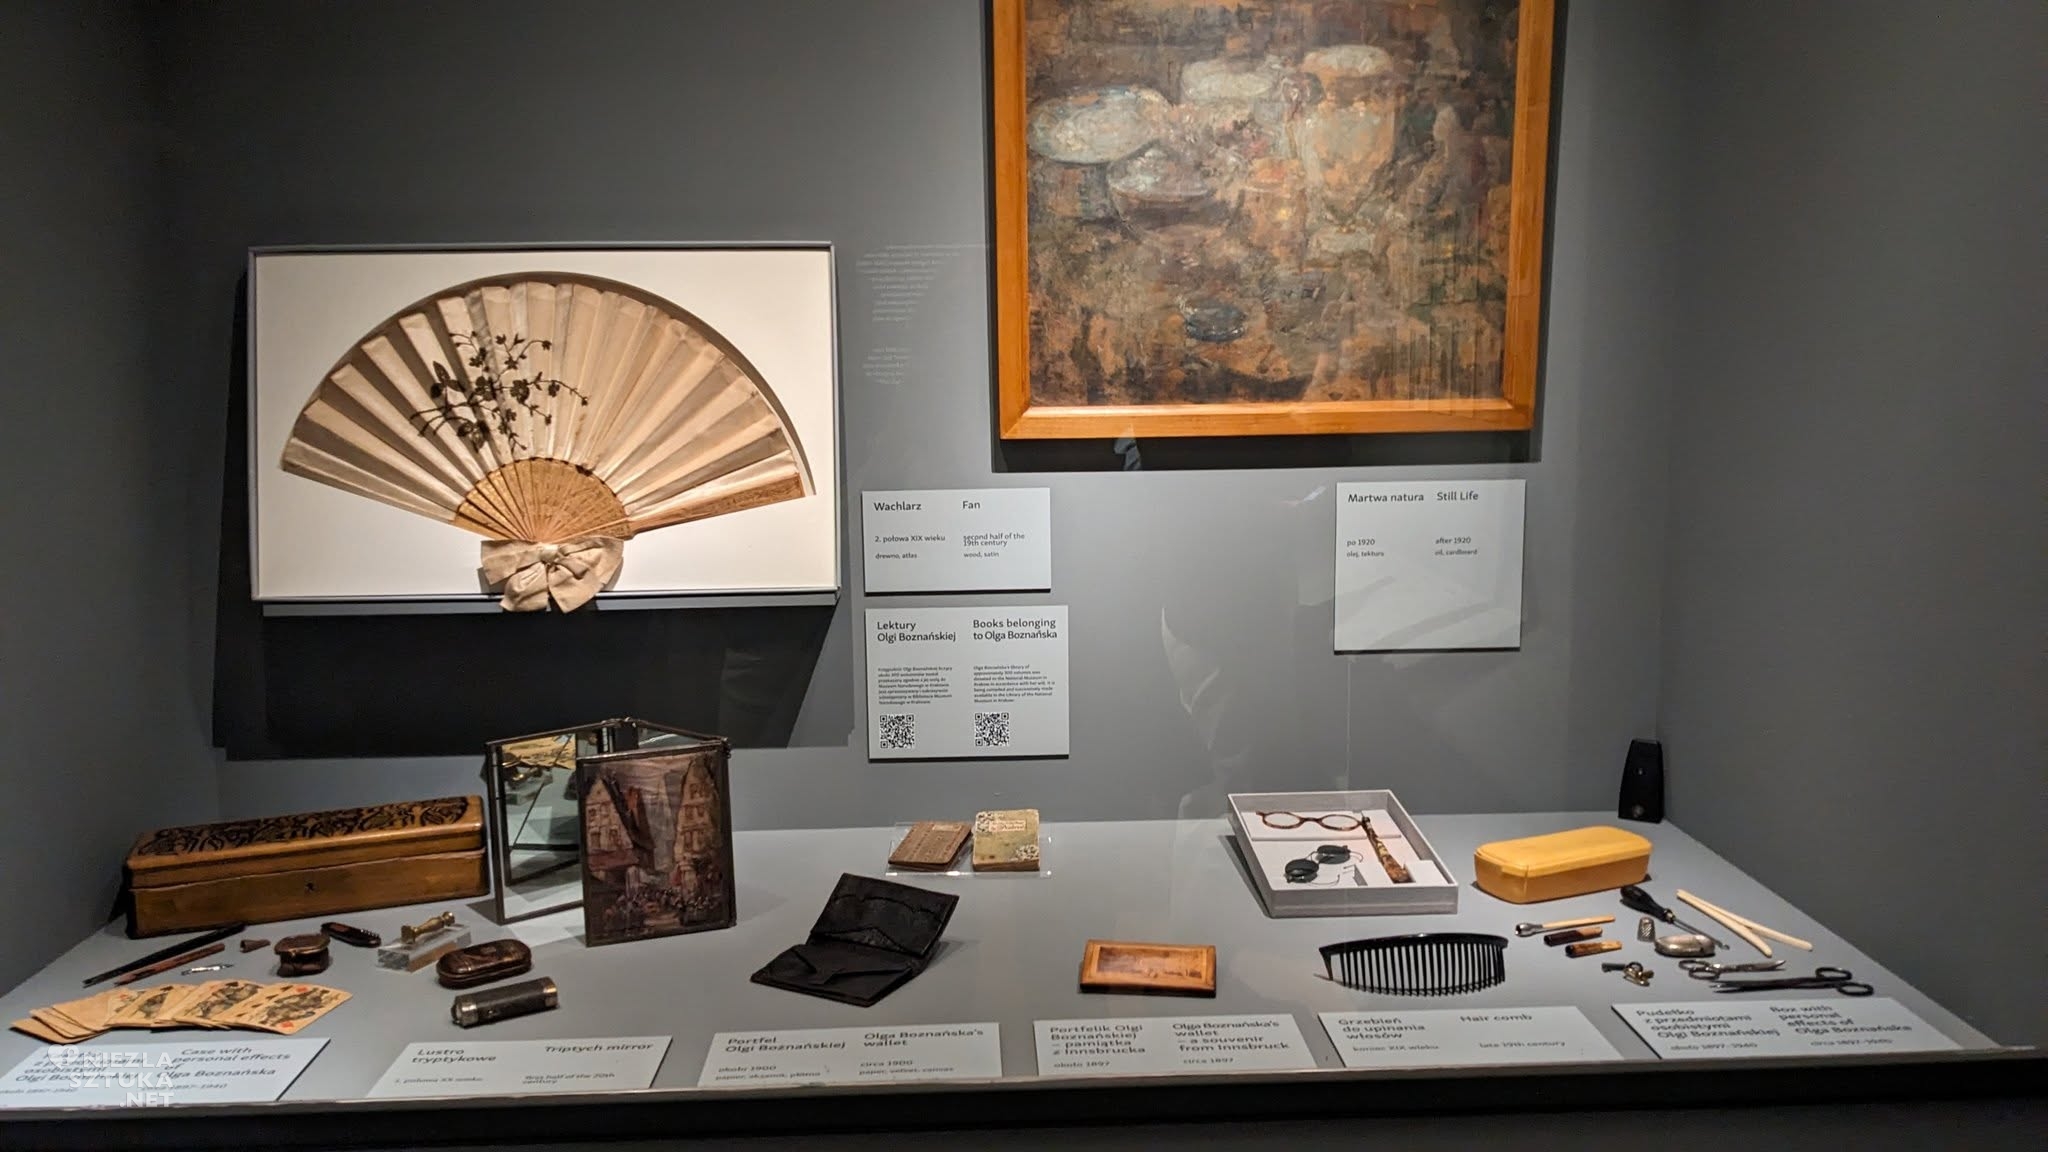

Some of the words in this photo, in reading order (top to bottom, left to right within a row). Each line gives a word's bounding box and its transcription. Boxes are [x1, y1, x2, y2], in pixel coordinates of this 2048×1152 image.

[1348, 494, 1387, 502] Martwa
[1391, 494, 1424, 502] natura
[1437, 492, 1457, 501] Still
[1460, 491, 1478, 500] Life
[874, 501, 921, 511] Wachlarz
[963, 501, 980, 509] Fan
[877, 622, 916, 631] Lektury
[973, 620, 1004, 628] Books
[1007, 619, 1056, 629] belonging
[878, 633, 896, 644] Olgi
[899, 632, 956, 641] Boznańskiej
[985, 631, 1005, 641] Olga
[1008, 630, 1057, 639] Boznańska
[1779, 1012, 1842, 1021] personal
[1203, 1020, 1279, 1029] Boznańska's
[900, 1029, 983, 1038] Boznańska's
[759, 1041, 845, 1051] Boznańskiej
[1065, 1040, 1131, 1048] pamiątka
[546, 1045, 602, 1053] Triptych
[172, 1055, 238, 1063] personal
[195, 1068, 276, 1077] Boznańska
